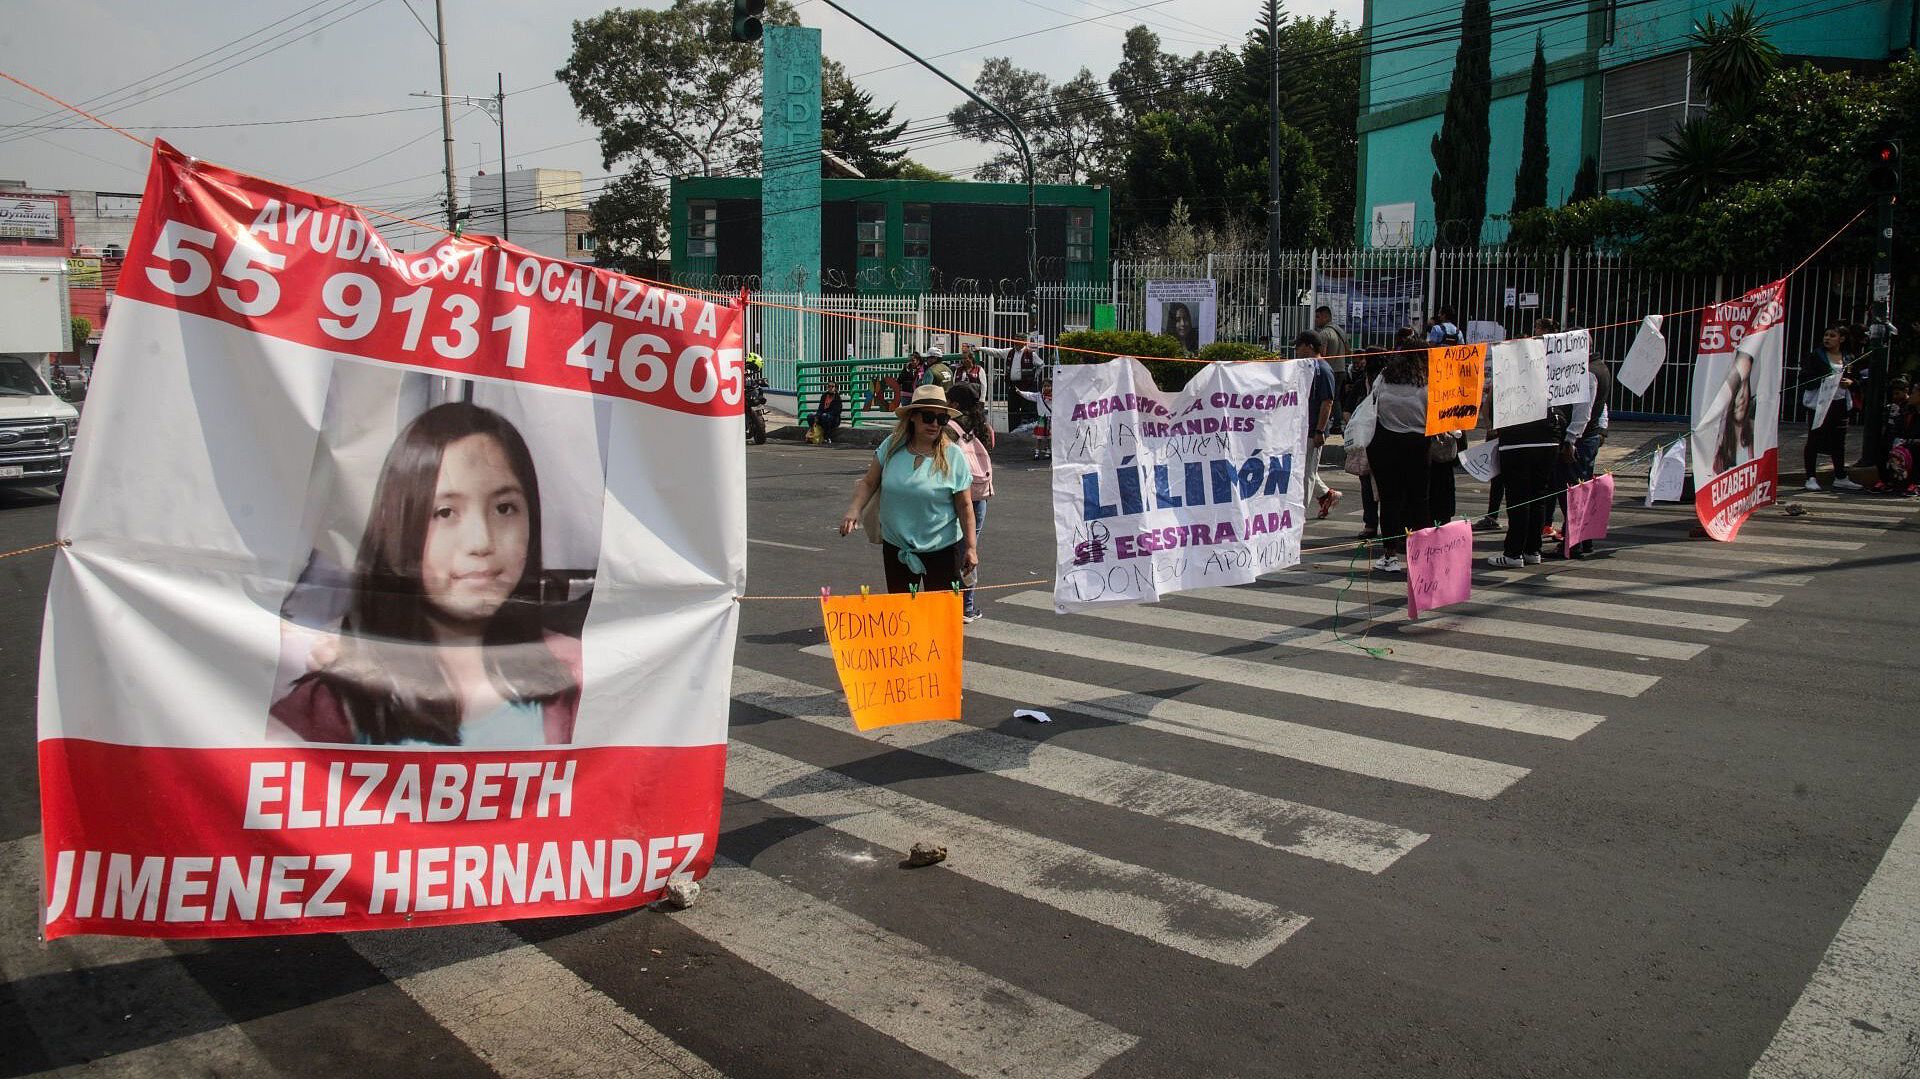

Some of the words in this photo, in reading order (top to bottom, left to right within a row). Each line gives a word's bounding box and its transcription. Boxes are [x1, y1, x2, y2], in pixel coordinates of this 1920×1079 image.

[145, 219, 289, 318] 55
[317, 273, 531, 369] 9131
[565, 320, 743, 406] 4605
[463, 247, 484, 287] A
[496, 255, 684, 331] LOCALIZAR
[692, 305, 717, 339] A
[1711, 464, 1758, 508] ELIZABETH
[827, 610, 911, 642] PEDIMOS
[927, 638, 941, 662] A
[242, 759, 577, 830] ELIZABETH
[47, 849, 352, 925] JIMENEZ
[367, 832, 705, 915] HERNANDEZ
